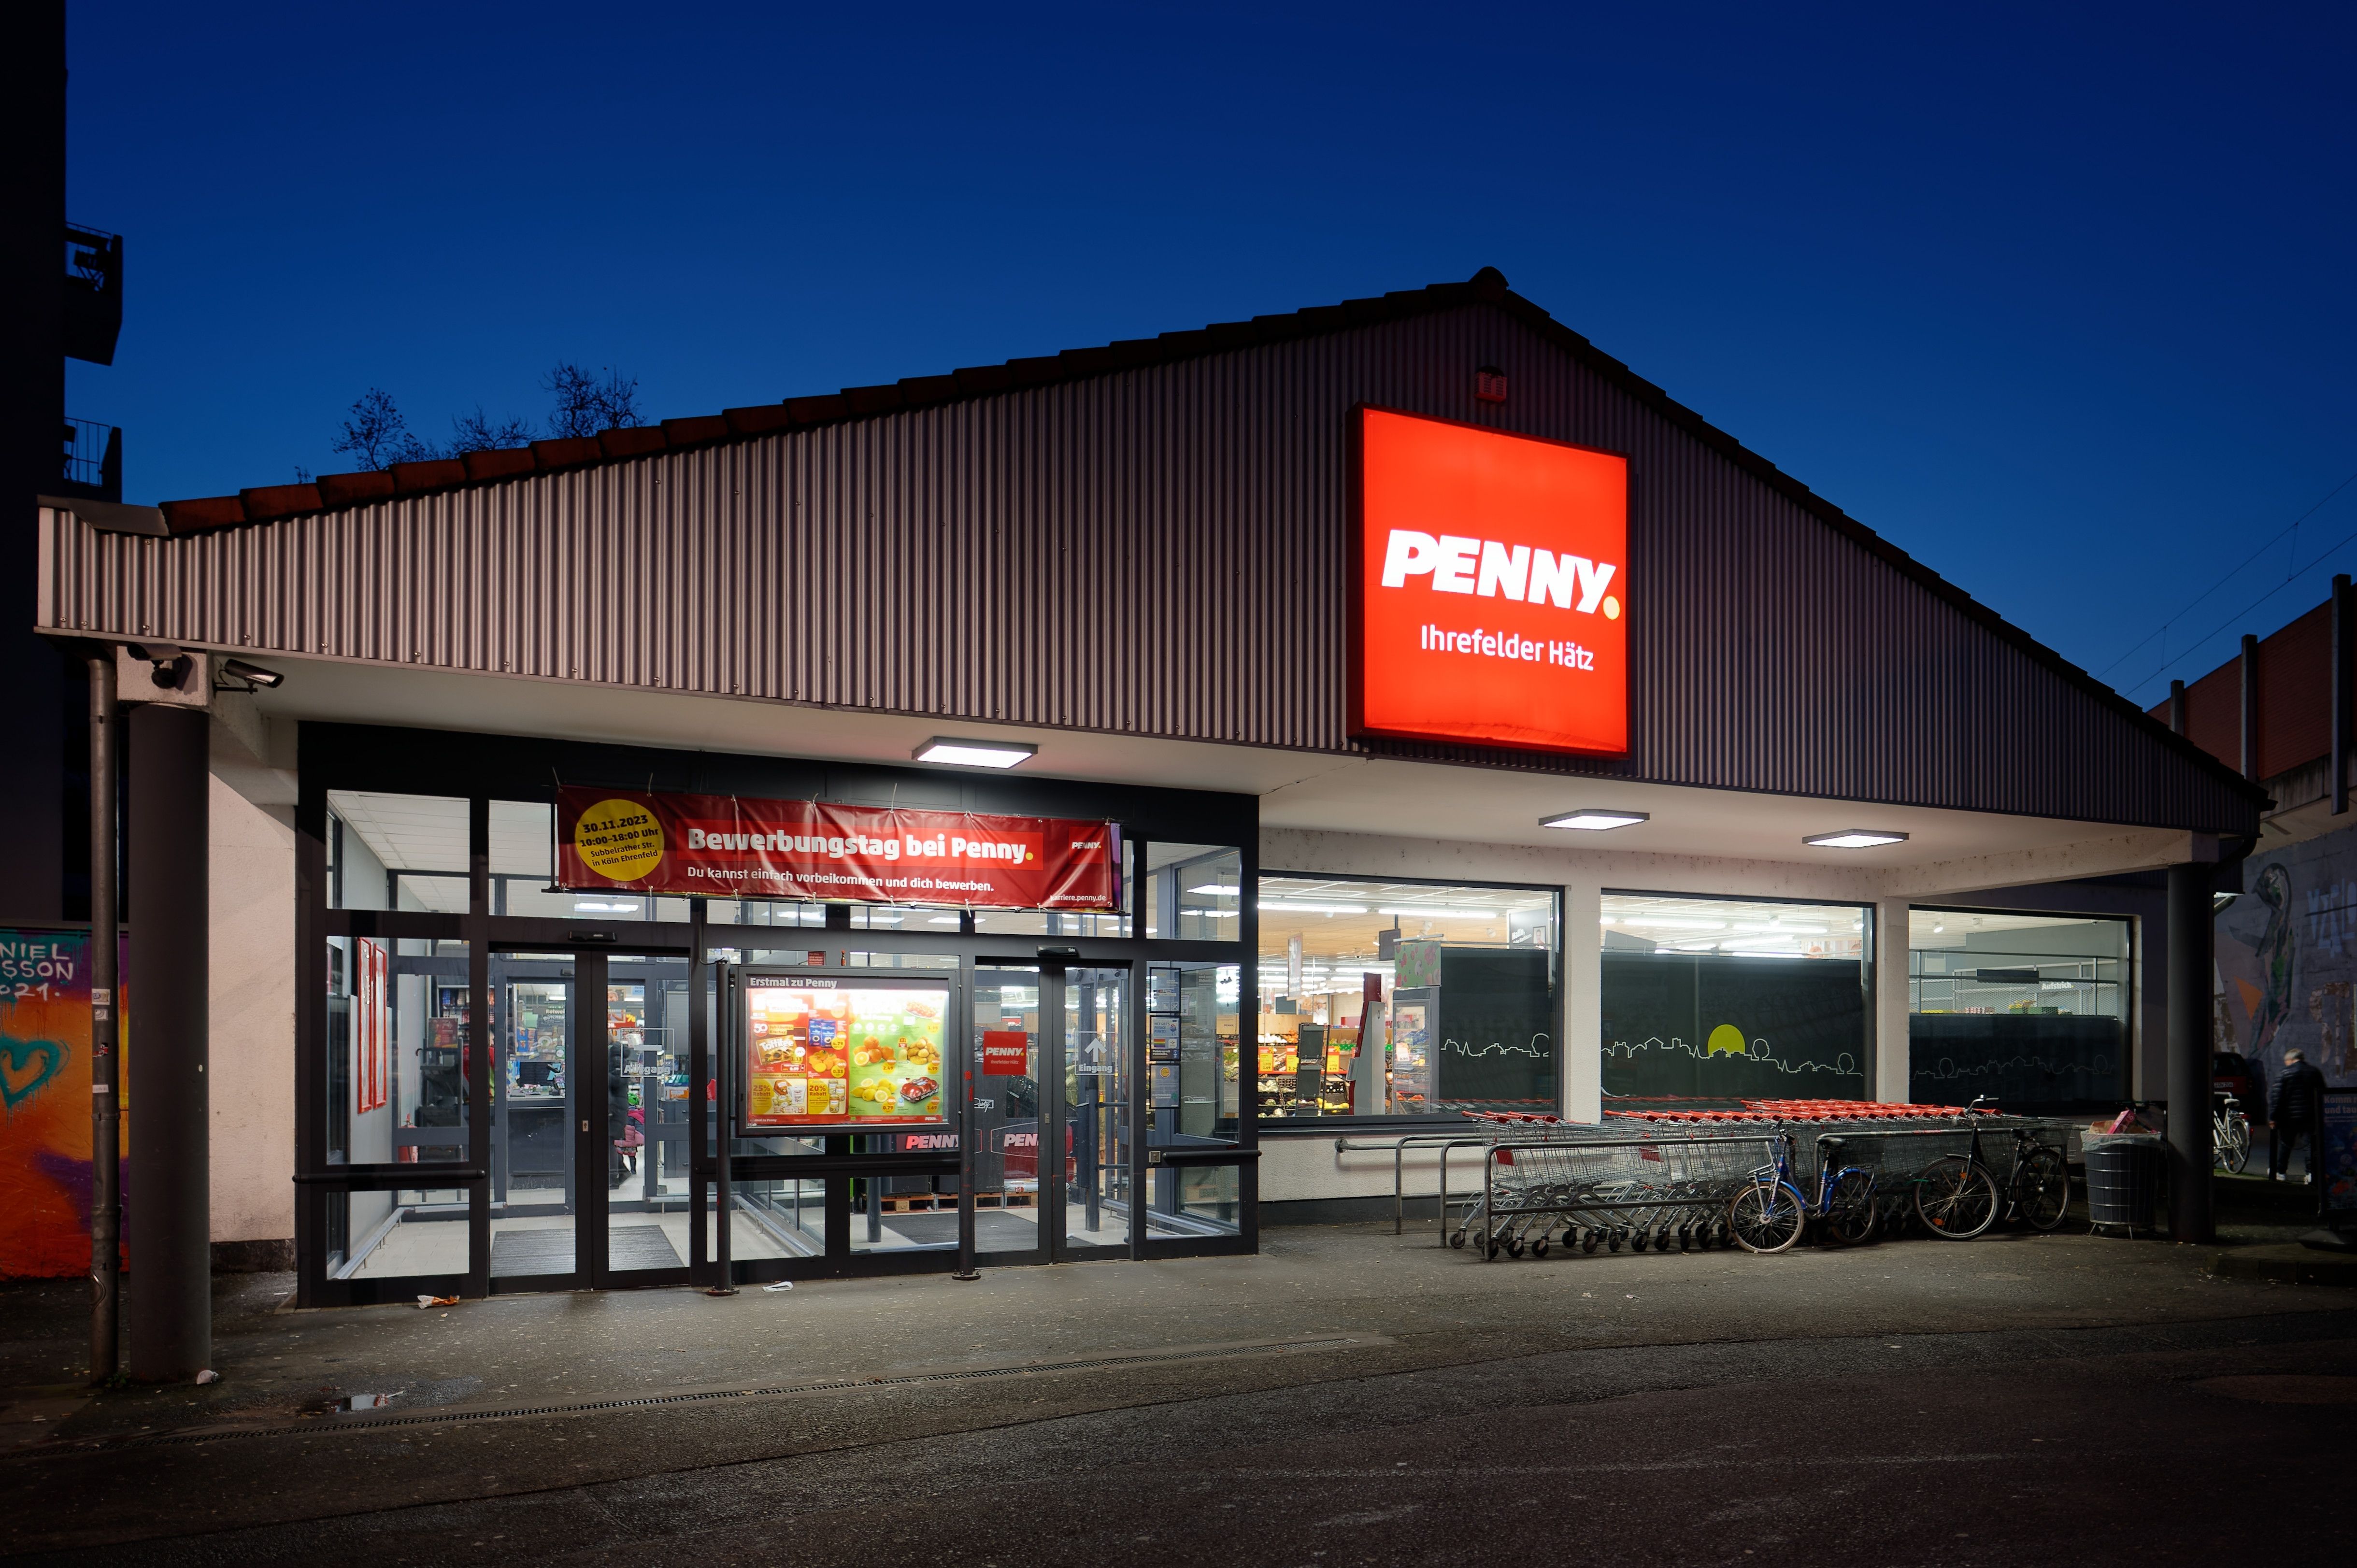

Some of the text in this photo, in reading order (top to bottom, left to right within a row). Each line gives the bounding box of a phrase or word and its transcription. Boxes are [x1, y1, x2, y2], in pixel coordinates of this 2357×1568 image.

[1382, 529, 1620, 620] PENNY.
[1421, 625, 1594, 671] Ihrefelder Hätz
[583, 815, 648, 833] 30.11.2023
[642, 828, 658, 837] Uhr
[590, 844, 641, 857] Subbelrather
[688, 828, 1034, 865] Bewerbungstag bei Penny.
[601, 857, 619, 865] Köln
[621, 850, 658, 862] Ehrenfeld
[687, 867, 994, 892] Du kannst einfach vorbeikommen und dich bewerben.
[1050, 894, 1107, 902] karriere.penny.de
[1, 959, 73, 981] SSON
[750, 977, 790, 986] Erstmal
[805, 978, 838, 989] Penny
[1078, 1064, 1113, 1073] Eingang
[2324, 1105, 2341, 1114] und
